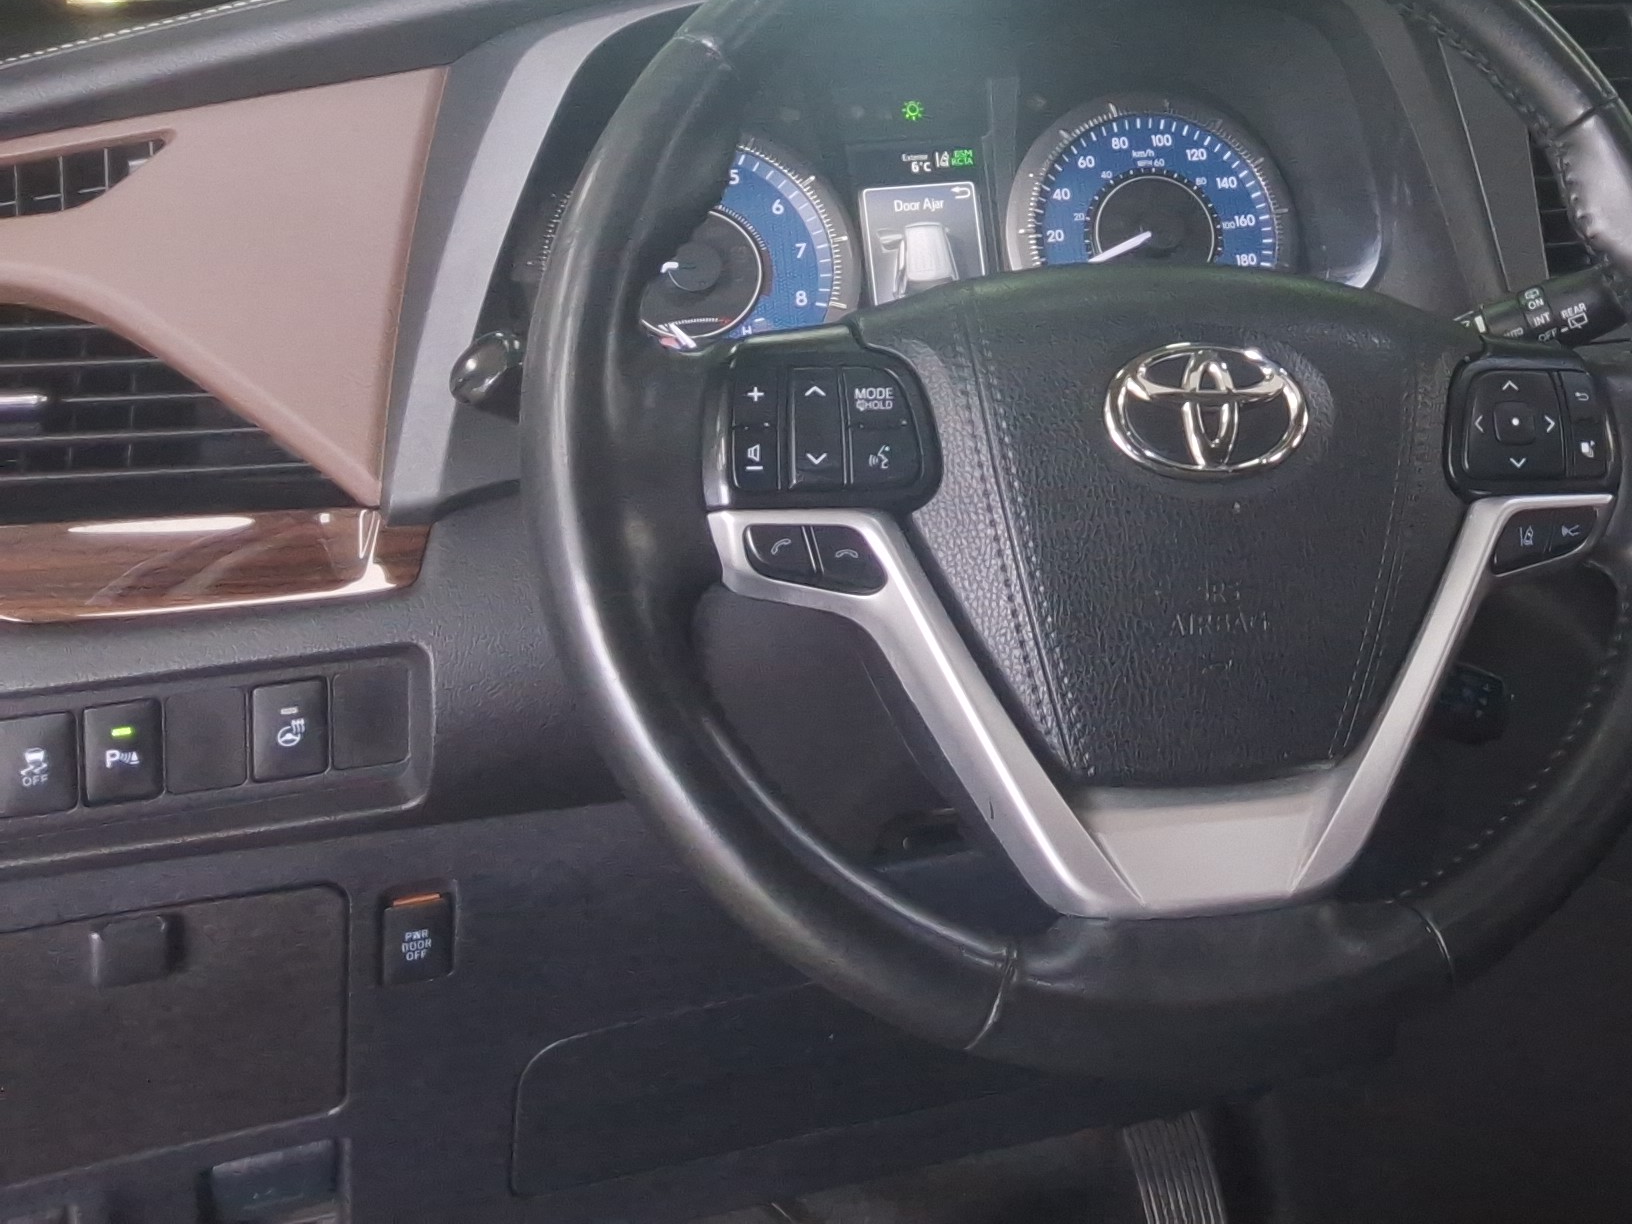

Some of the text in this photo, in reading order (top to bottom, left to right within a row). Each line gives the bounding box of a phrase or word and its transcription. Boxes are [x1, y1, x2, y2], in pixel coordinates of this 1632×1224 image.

[1111, 137, 1129, 149] 80
[1151, 134, 1173, 147] 100
[1131, 149, 1155, 159] km/h
[1186, 148, 1208, 161] 120
[1078, 156, 1095, 168] 60
[1153, 158, 1165, 167] 60
[729, 169, 740, 185] 5
[1216, 177, 1238, 189] 140
[1053, 188, 1071, 201] 40
[772, 199, 784, 215] 6
[893, 197, 945, 213] Door Ajar
[1234, 215, 1256, 227] 160
[1047, 230, 1065, 242] 20
[795, 243, 807, 259] 7
[1236, 254, 1257, 266] 180
[795, 290, 808, 306] 8
[1528, 298, 1545, 310] ON
[1560, 302, 1588, 319] REAR
[1533, 312, 1551, 327] INT
[1538, 327, 1558, 343] OFF
[854, 387, 895, 400] MODE
[864, 400, 893, 411] HOLD
[22, 774, 48, 787] OFF
[405, 949, 428, 961] OFF
